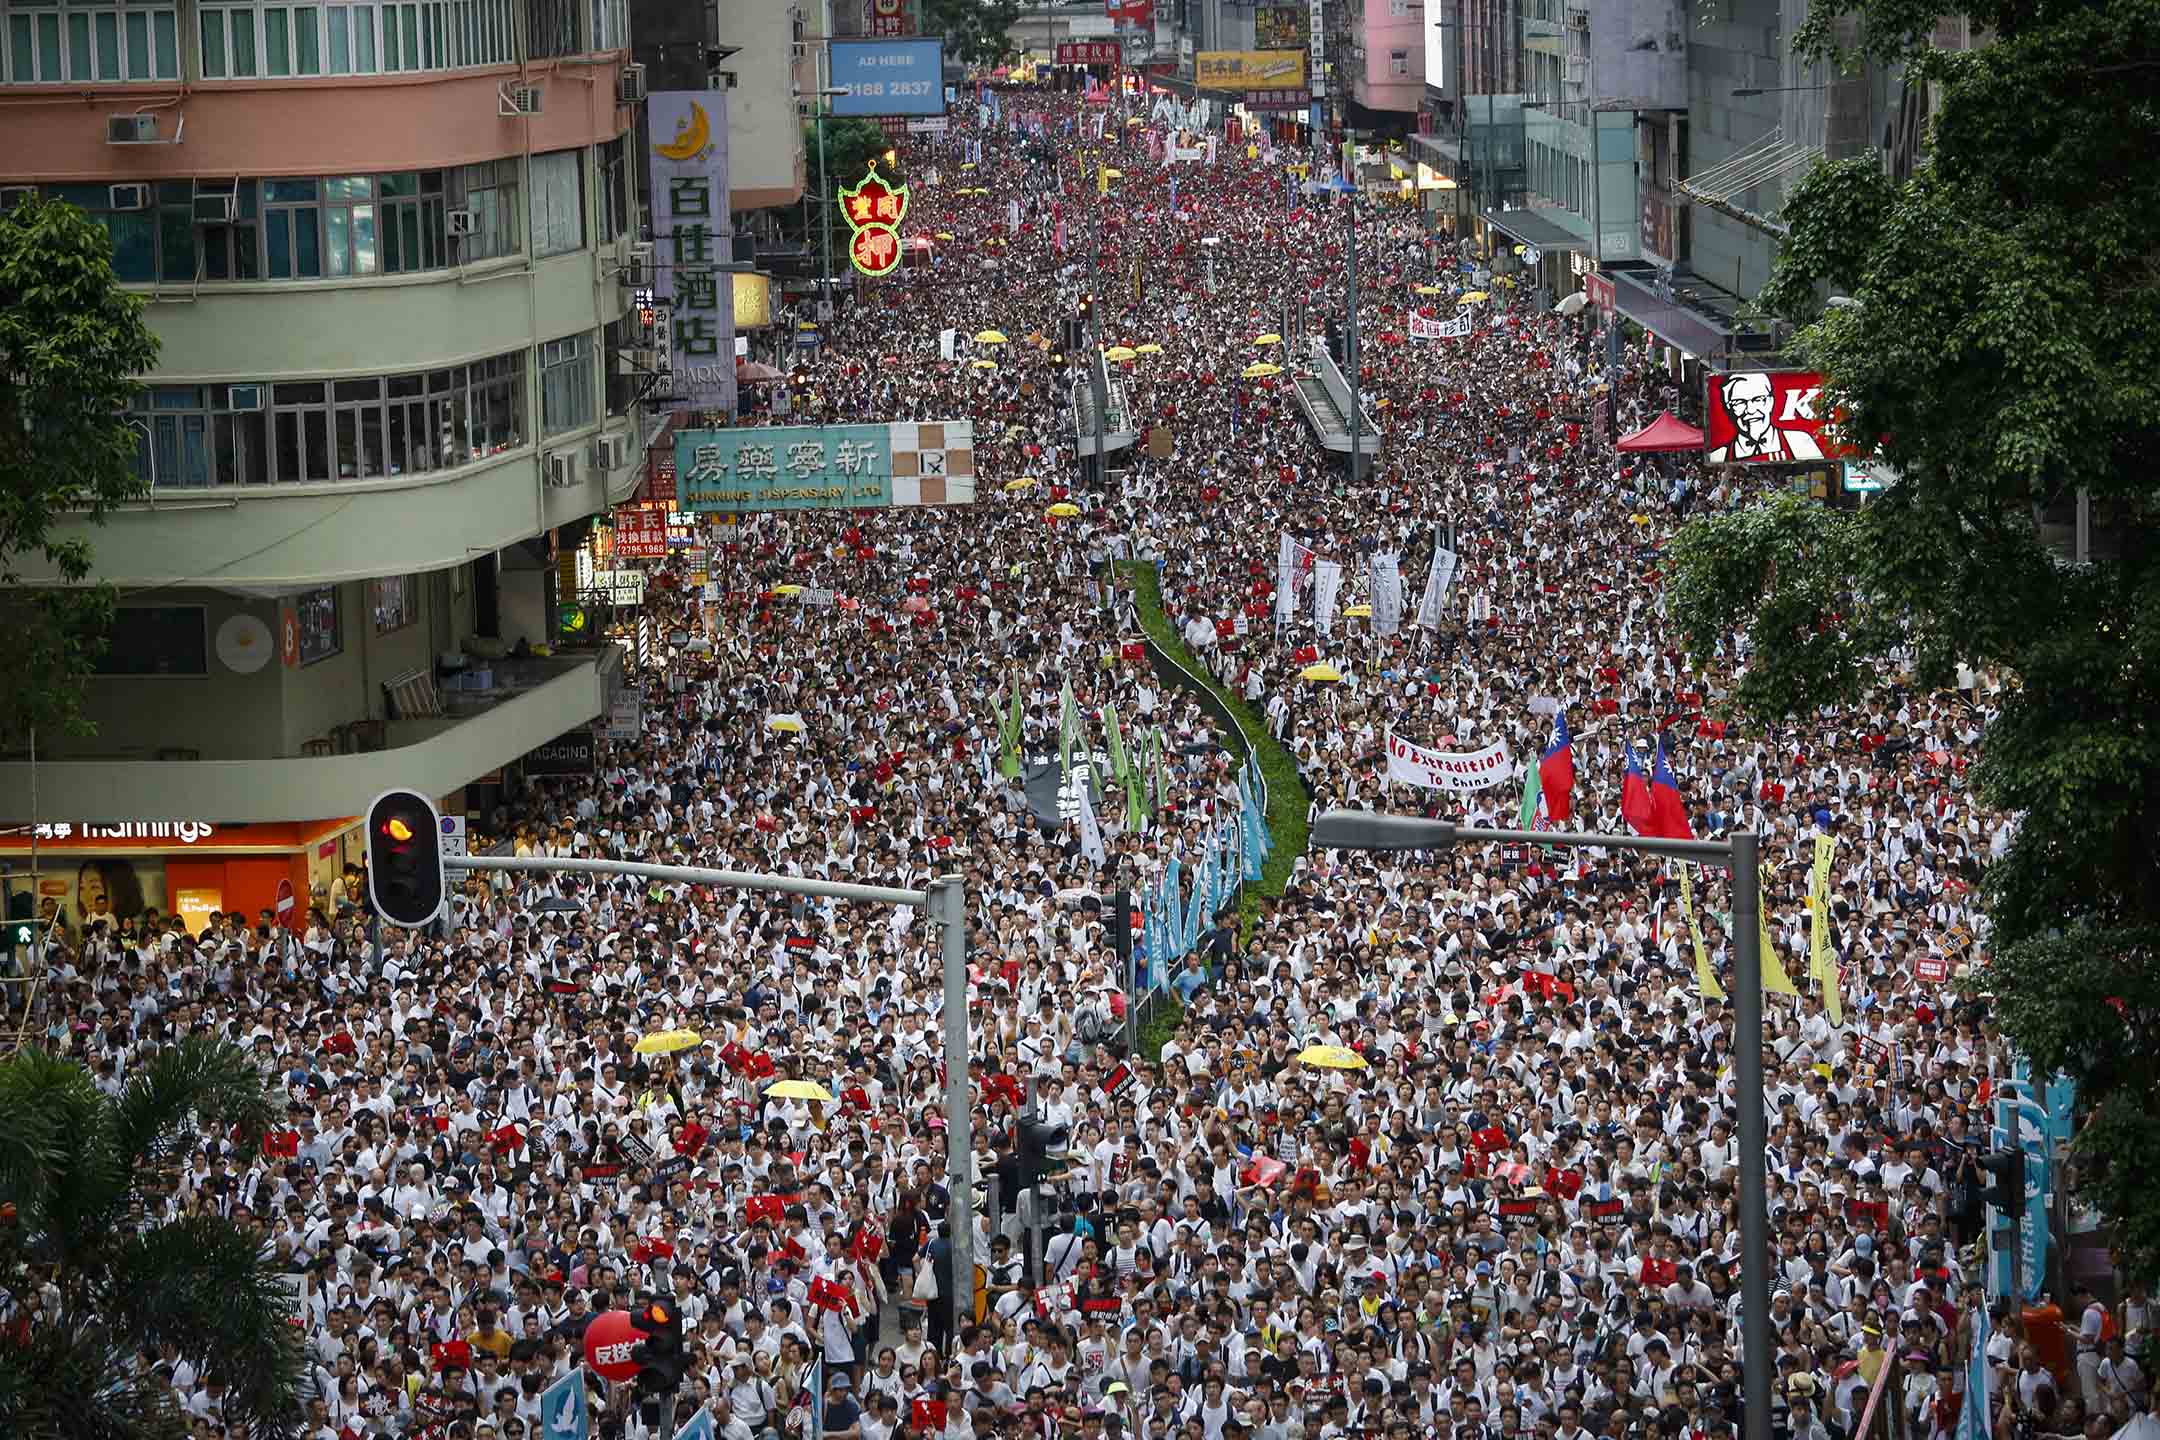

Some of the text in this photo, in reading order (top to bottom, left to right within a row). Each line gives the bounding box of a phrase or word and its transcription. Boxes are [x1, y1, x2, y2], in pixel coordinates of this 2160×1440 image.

[670, 176, 718, 356] 百佳酒店
[618, 513, 659, 530] 許氏
[1411, 747, 1505, 774] Extradition
[1428, 772, 1490, 788] To China
